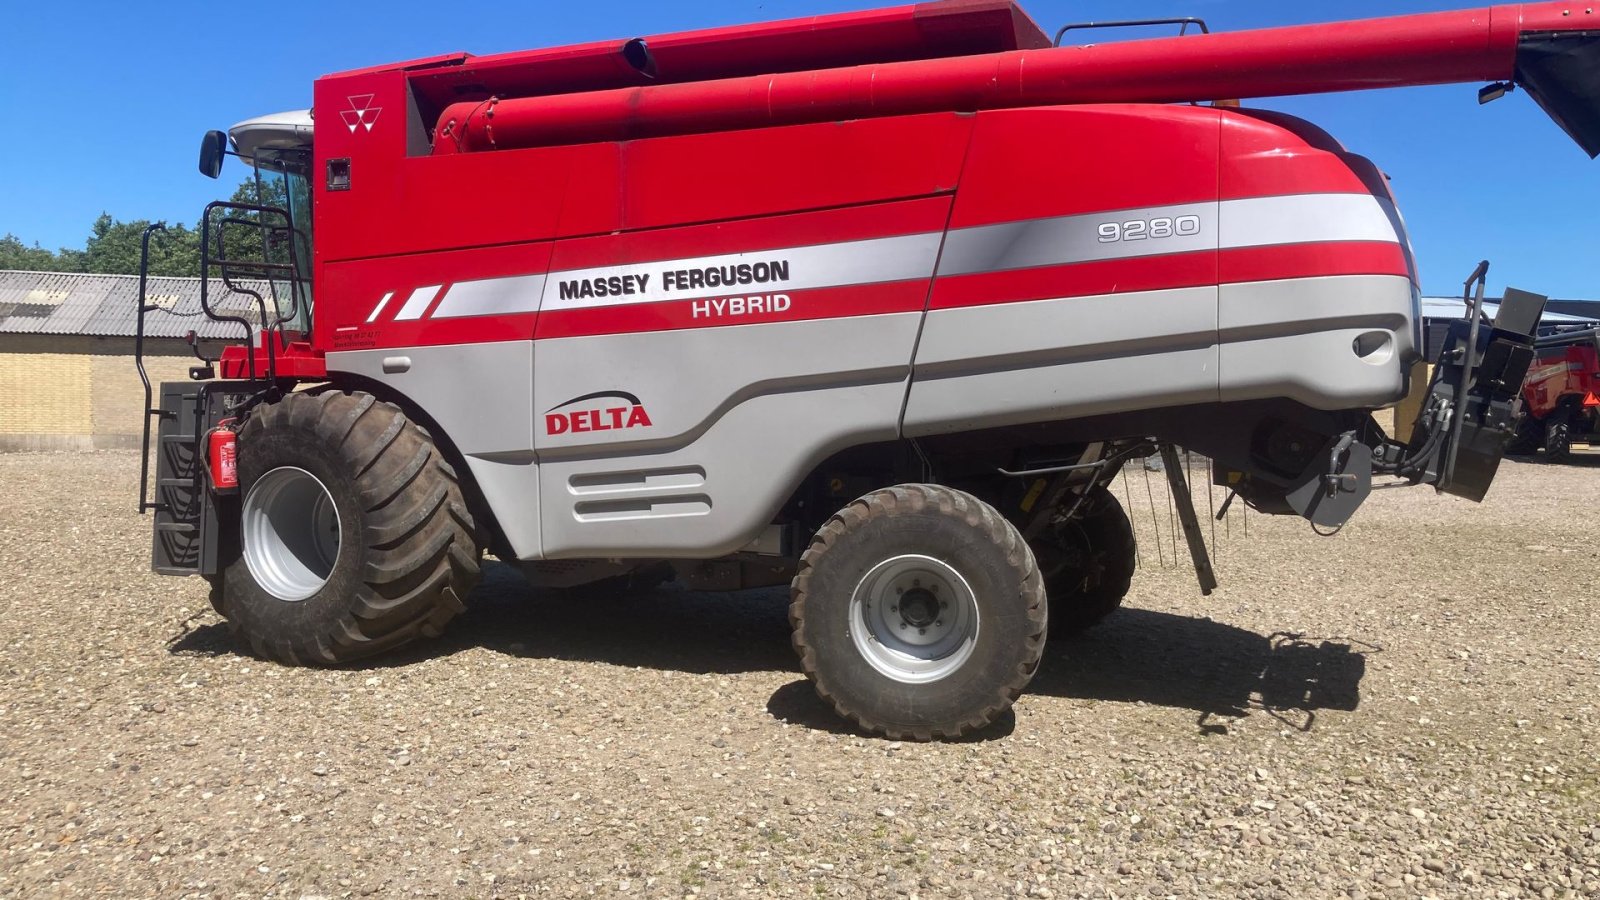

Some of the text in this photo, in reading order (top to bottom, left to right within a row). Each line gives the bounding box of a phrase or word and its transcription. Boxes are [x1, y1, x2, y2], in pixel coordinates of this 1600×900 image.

[1098, 214, 1200, 243] 9280
[559, 260, 790, 300] MASSEY FERGUSON
[692, 294, 791, 318] HYBRID
[545, 405, 653, 435] DELTA
